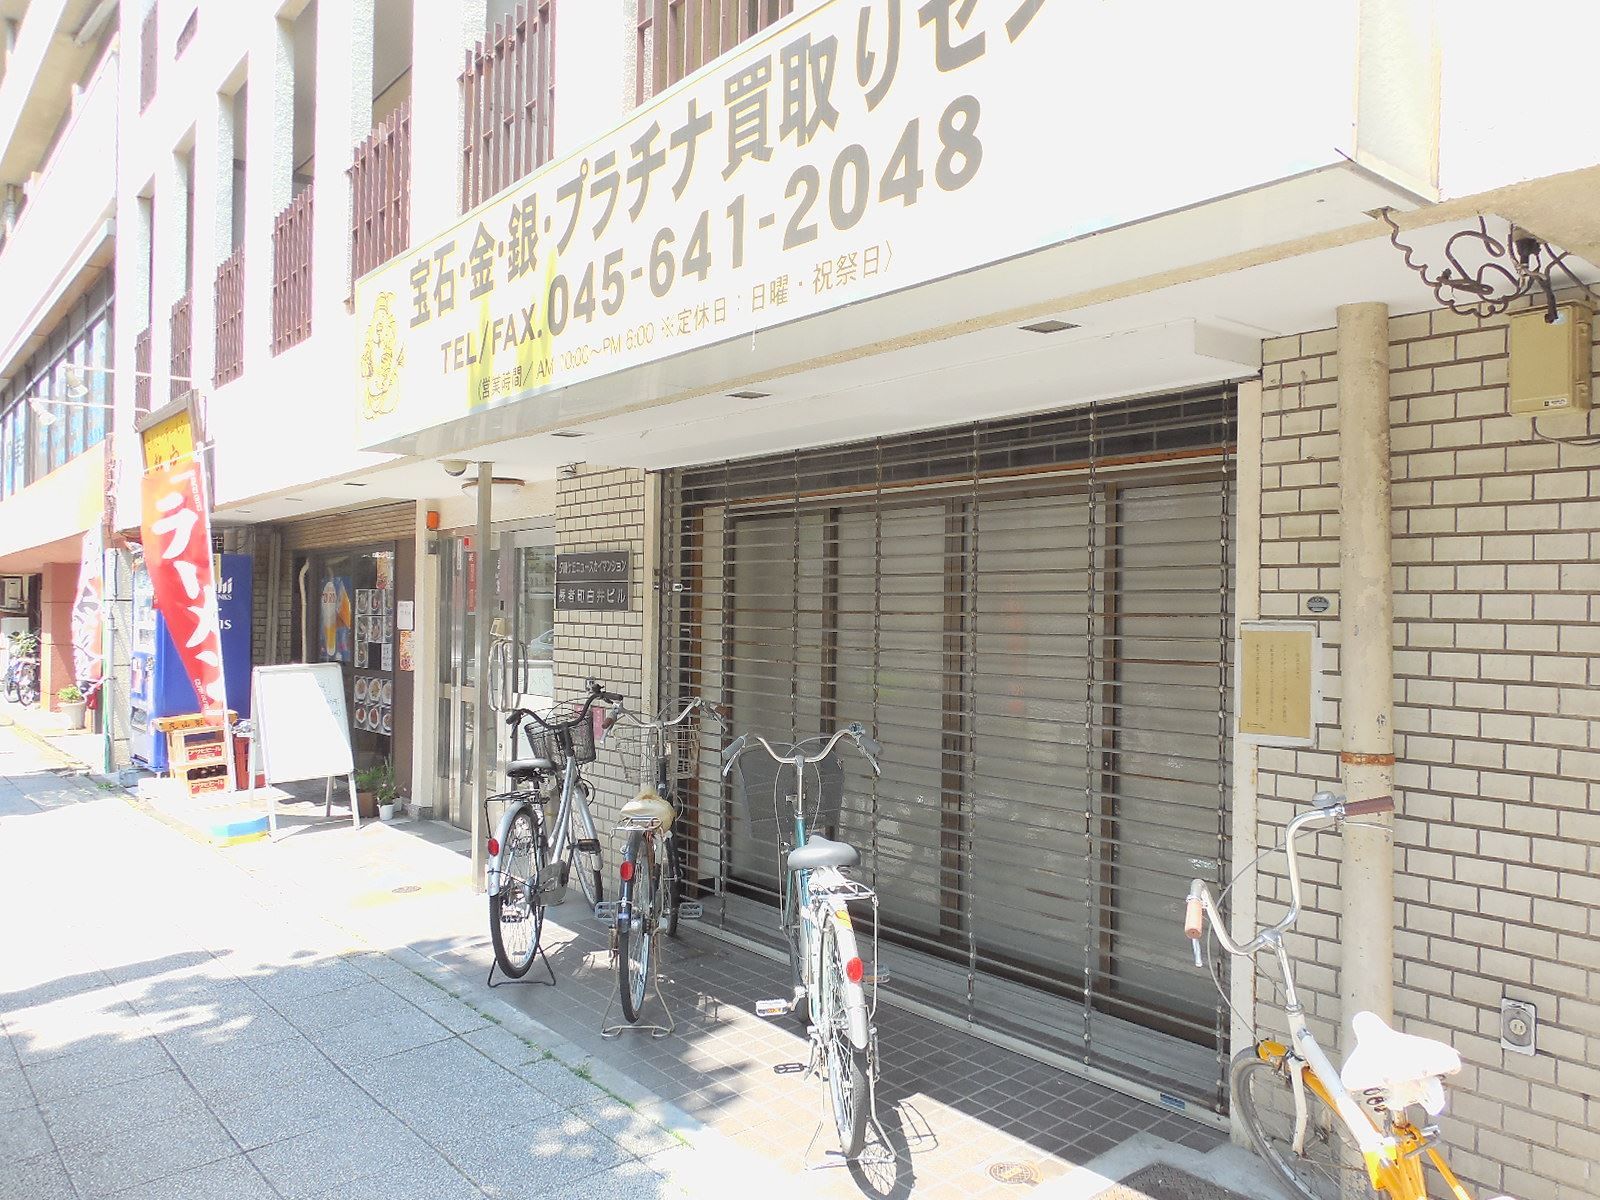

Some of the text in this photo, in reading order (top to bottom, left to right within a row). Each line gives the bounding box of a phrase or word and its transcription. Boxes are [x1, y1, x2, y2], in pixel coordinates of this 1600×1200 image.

[409, 0, 1046, 329] 宝石・金・銀・プラチナ買取りセ
[548, 94, 984, 337] 045-641-2048
